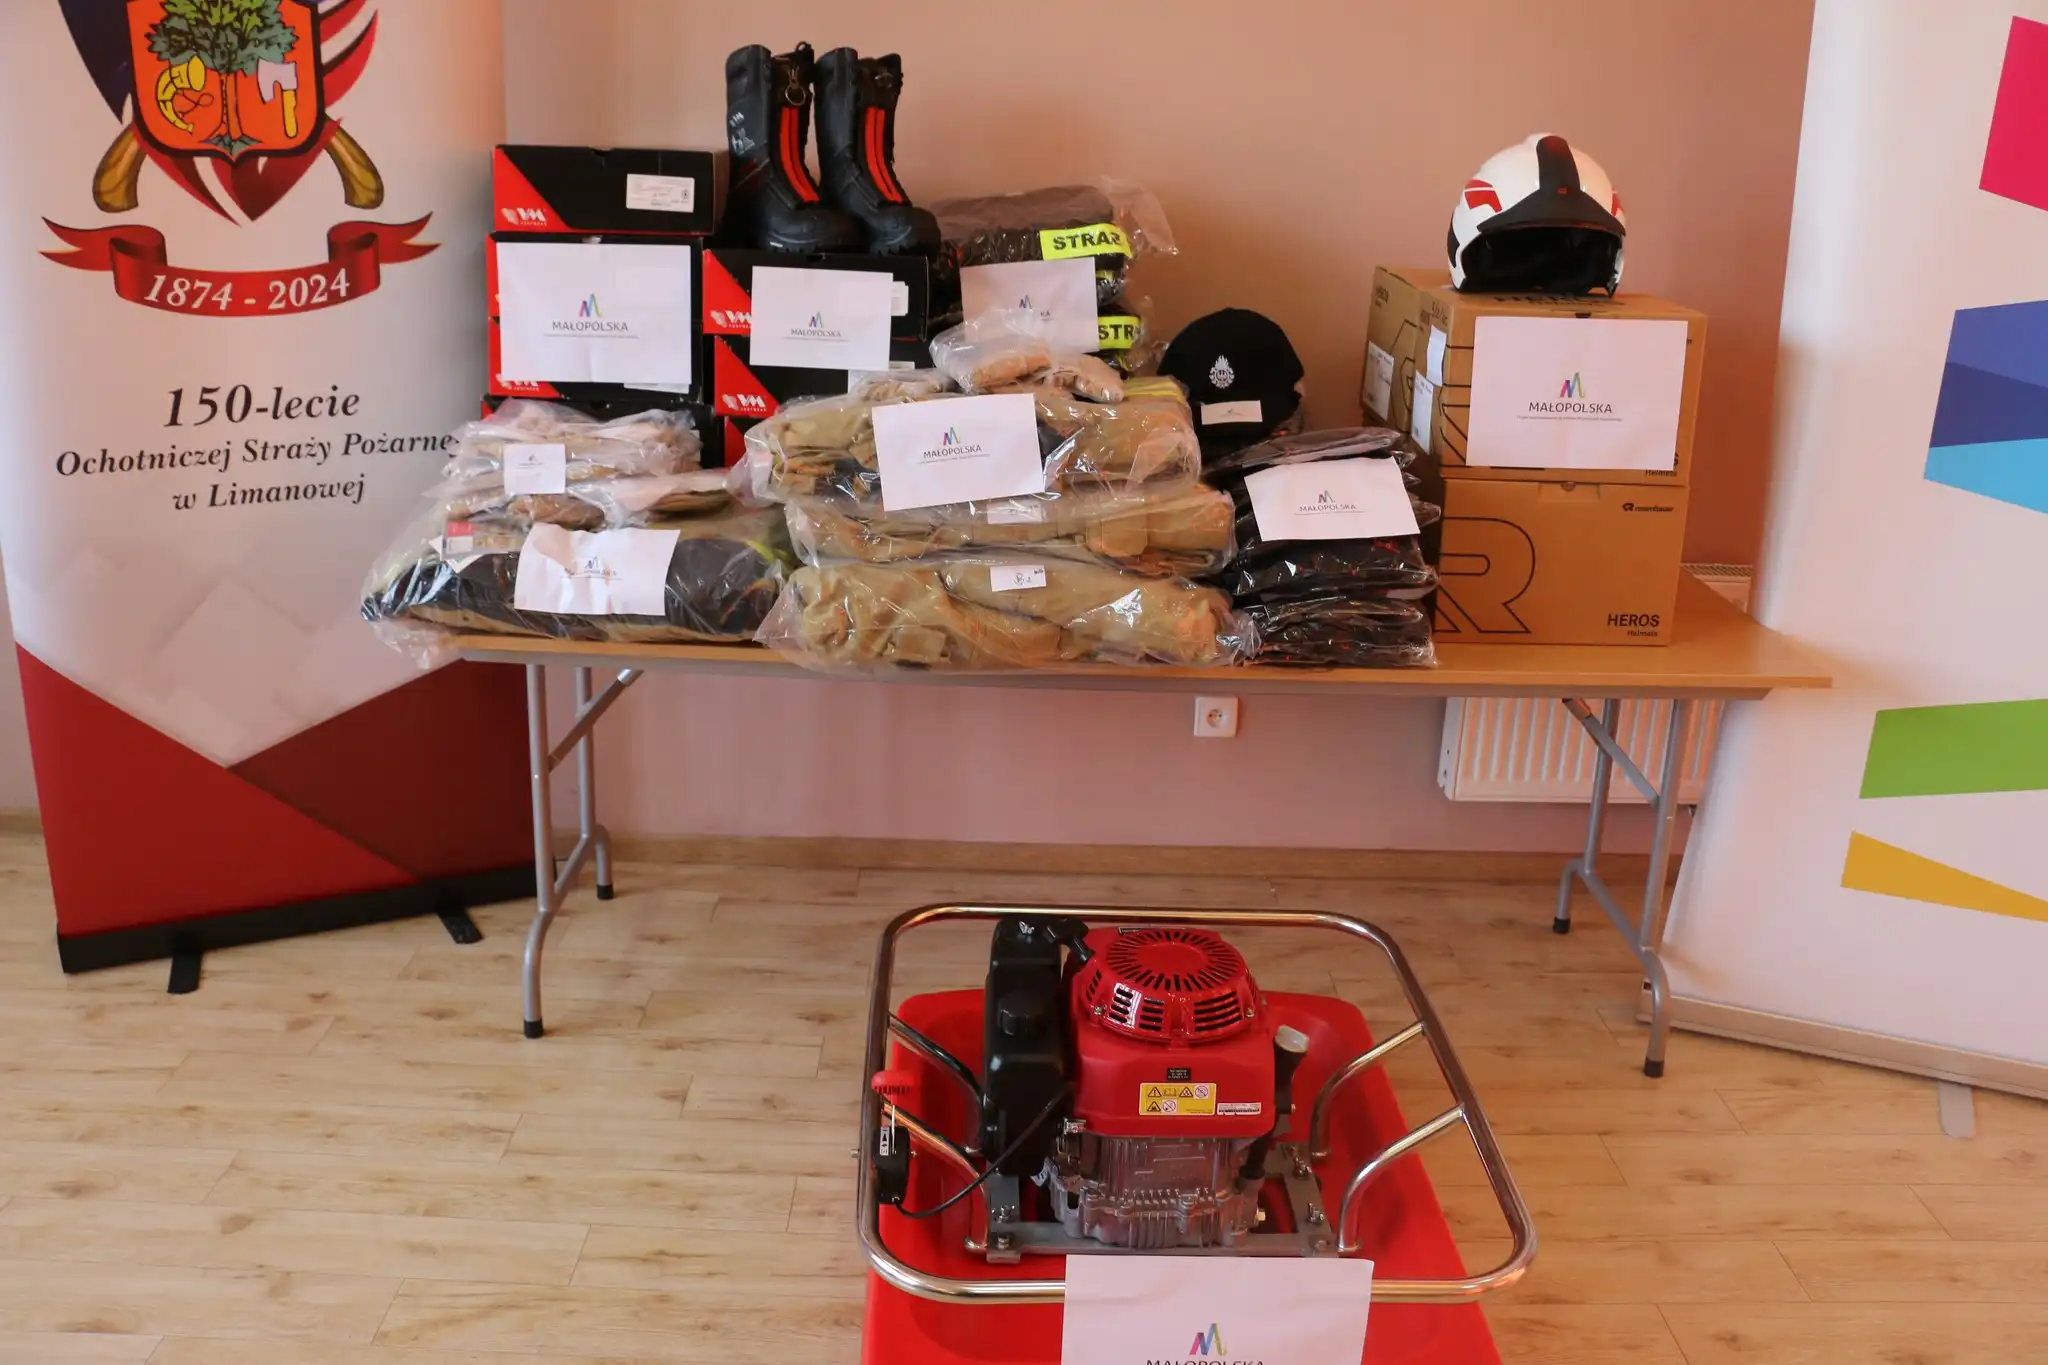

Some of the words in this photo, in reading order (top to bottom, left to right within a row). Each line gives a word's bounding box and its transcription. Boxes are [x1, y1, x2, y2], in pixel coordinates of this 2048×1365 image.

[144, 274, 233, 311] 1874
[244, 297, 256, 305] -
[268, 268, 350, 310] 2024
[552, 320, 629, 332] MAŁOPOLSKA
[1098, 323, 1135, 341] STR
[163, 383, 361, 428] 150-lecie
[1528, 401, 1613, 414] MAŁOPOLSKA
[55, 440, 232, 477] Ochotniczej
[242, 436, 332, 467] Straży
[923, 444, 982, 459] MAŁOPOLSKA
[172, 493, 197, 511] w
[208, 472, 366, 508] Limanowej
[1607, 613, 1660, 628] HEROS
